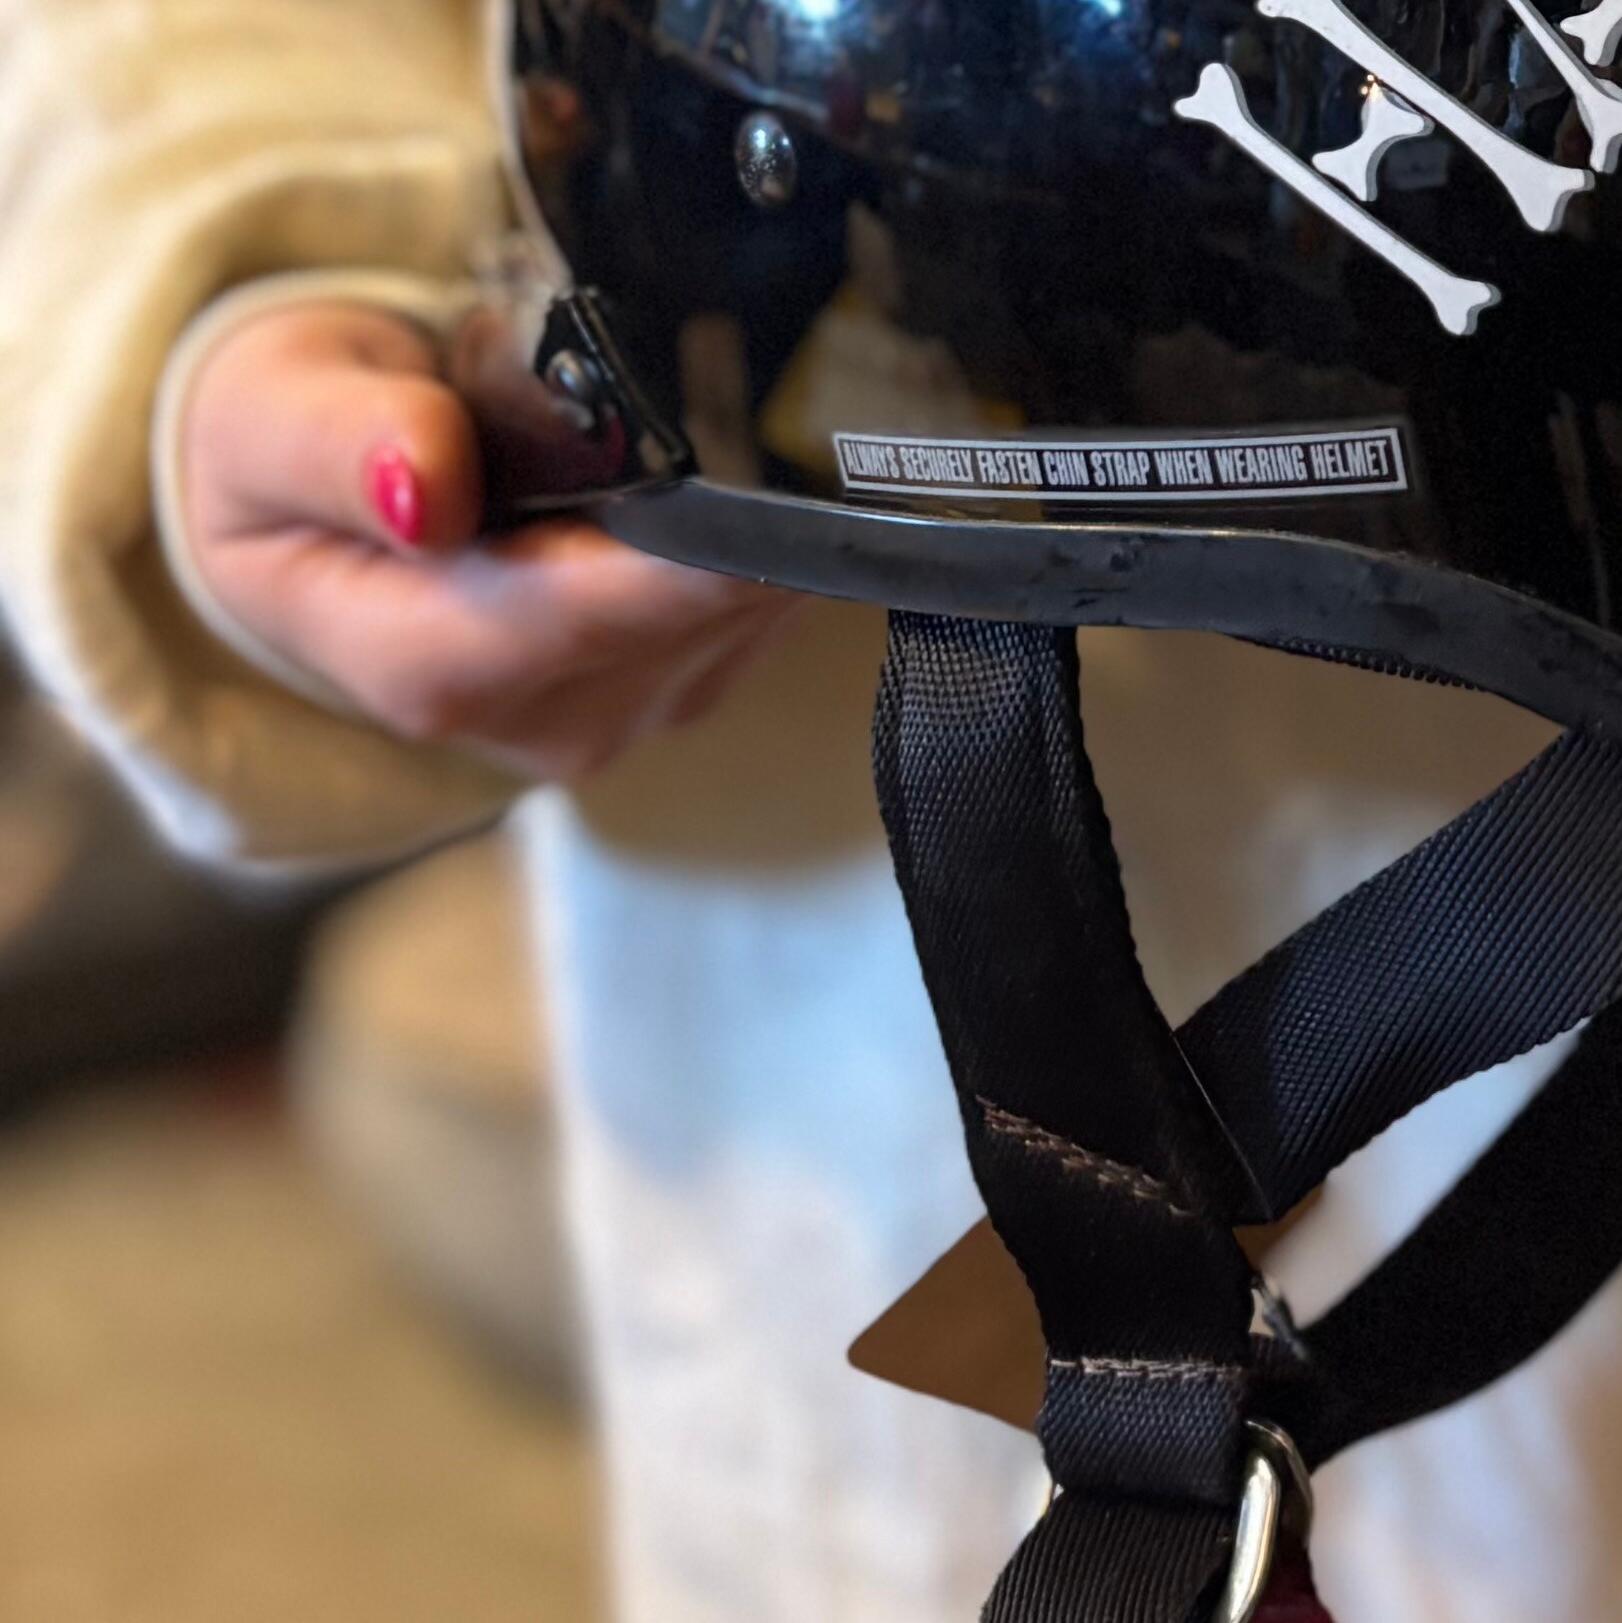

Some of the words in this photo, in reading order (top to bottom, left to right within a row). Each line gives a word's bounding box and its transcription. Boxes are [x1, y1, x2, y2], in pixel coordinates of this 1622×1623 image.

[843, 441, 899, 479] ALWAYS
[900, 446, 974, 483] SECURELY
[976, 450, 1043, 485] FASTEN
[1043, 450, 1090, 486] CHIN
[1091, 450, 1150, 486] STRAP
[1154, 448, 1214, 485] WHEN
[1215, 444, 1306, 483] WEARING
[1309, 439, 1390, 481] HELMET
